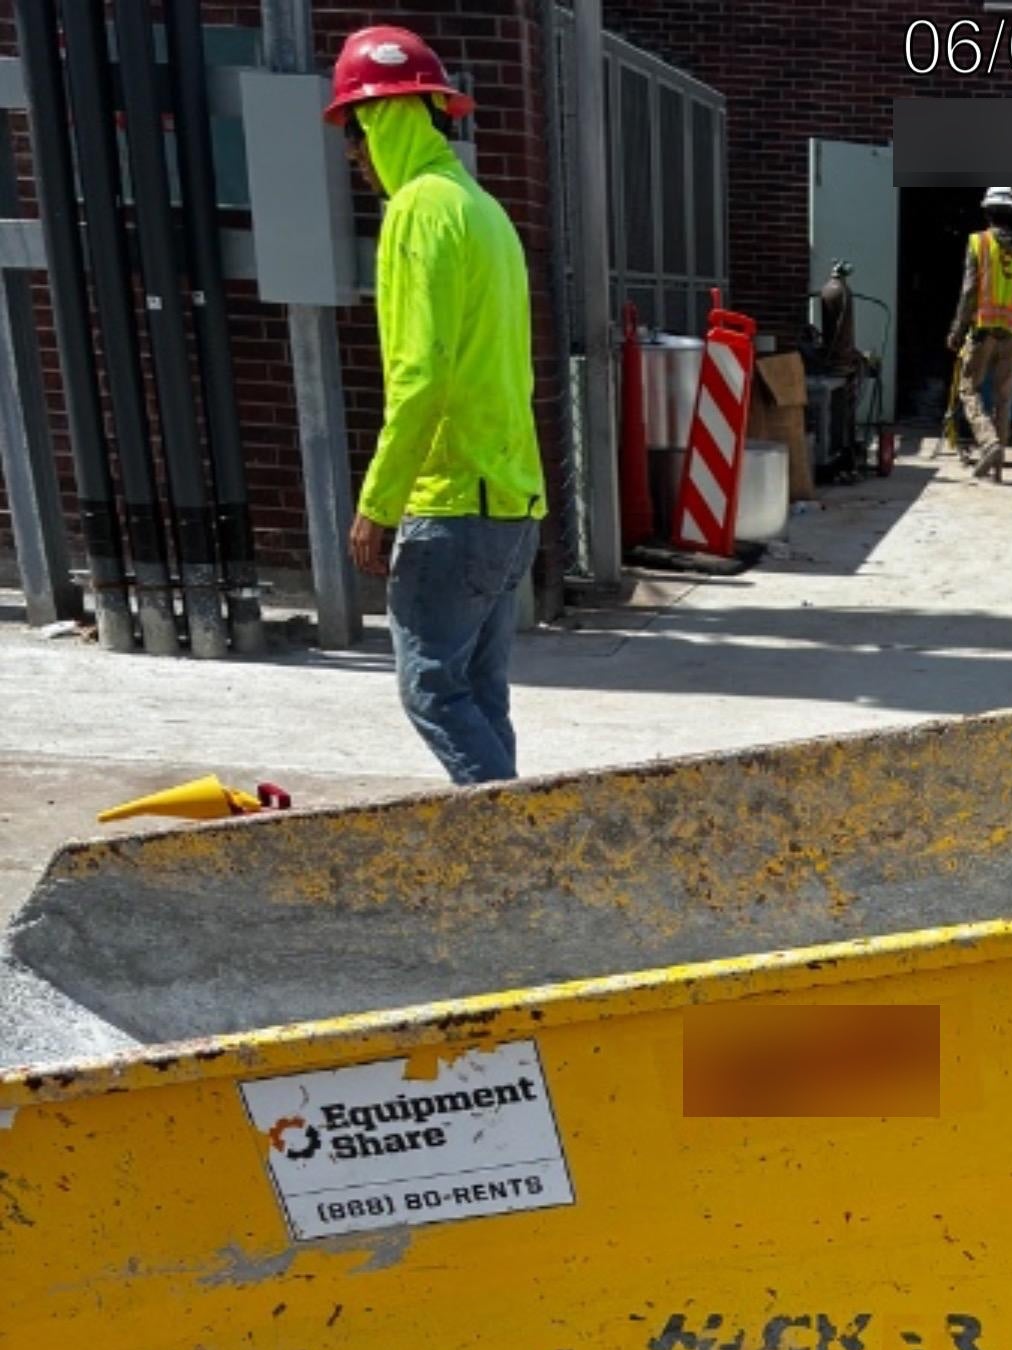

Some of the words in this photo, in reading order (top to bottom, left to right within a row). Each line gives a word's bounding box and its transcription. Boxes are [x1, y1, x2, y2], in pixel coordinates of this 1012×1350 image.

[320, 1076, 537, 1131] Equipment
[331, 1125, 447, 1159] Share
[317, 1194, 395, 1223] (888)
